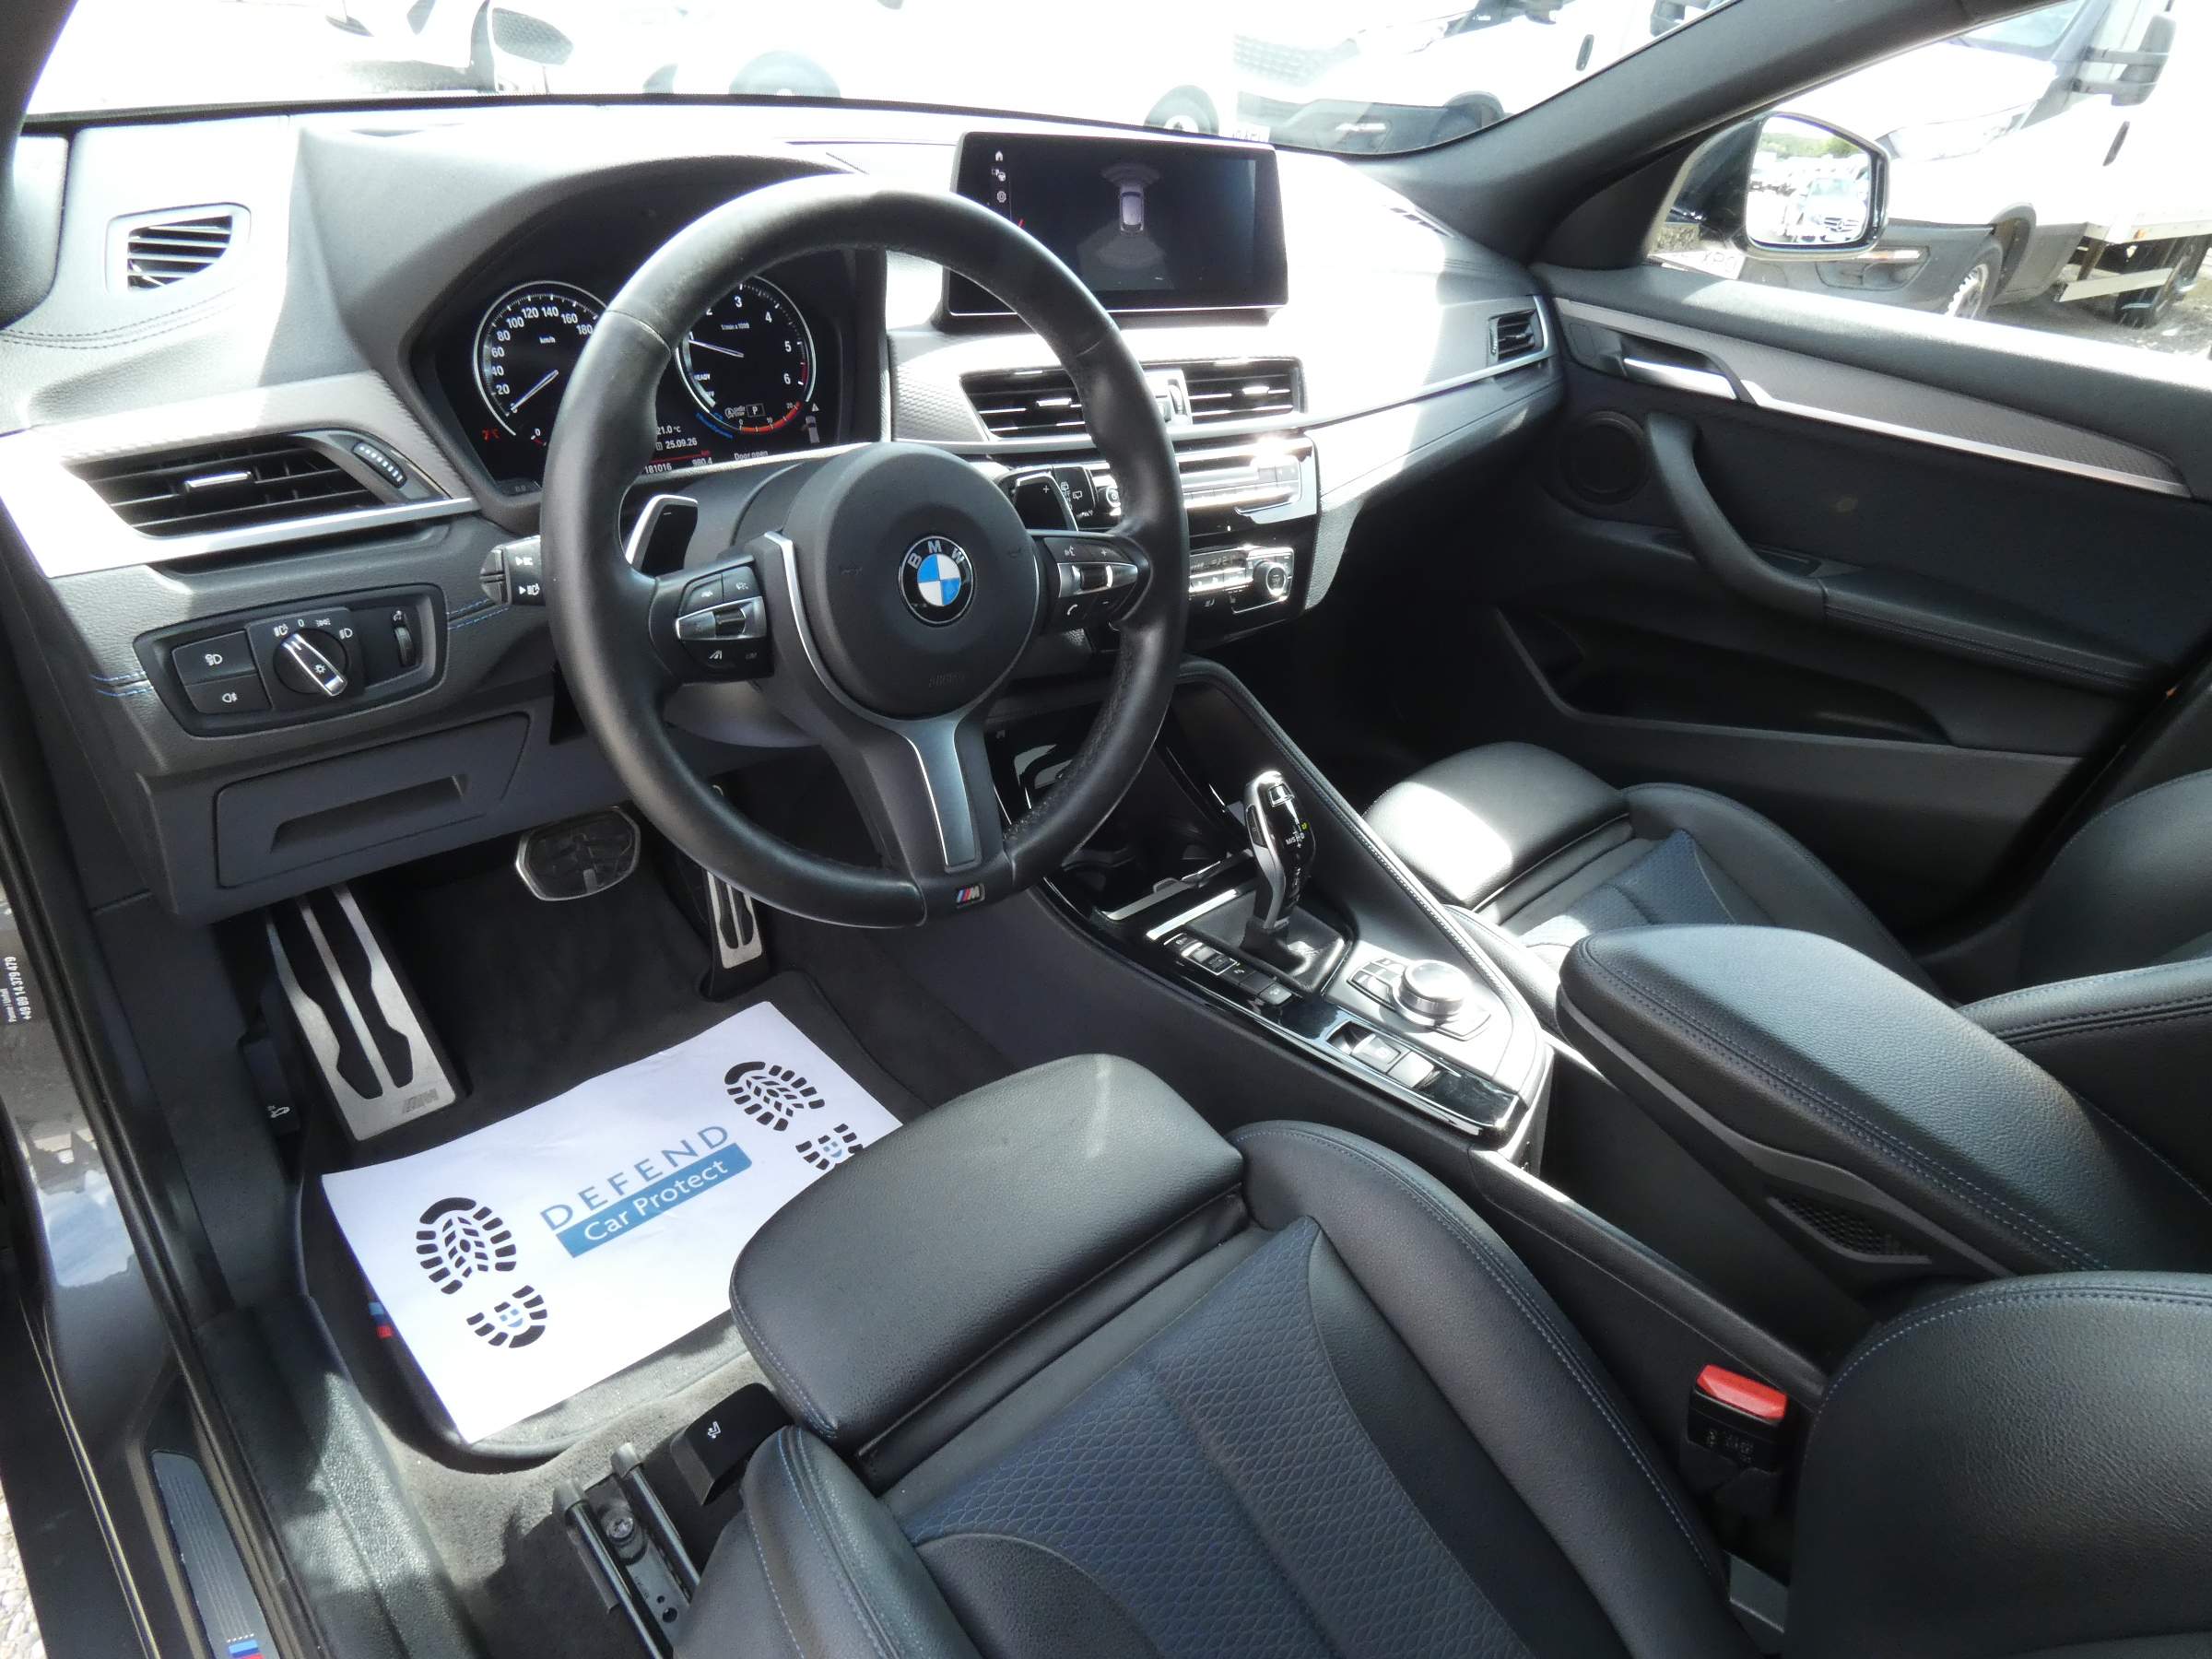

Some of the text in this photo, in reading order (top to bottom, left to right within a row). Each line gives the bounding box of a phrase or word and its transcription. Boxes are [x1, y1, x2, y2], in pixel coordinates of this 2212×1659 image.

[735, 296, 743, 308] 3
[522, 307, 539, 319] 120
[541, 306, 559, 318] 140
[765, 312, 772, 324] 4
[506, 316, 524, 329] 100
[560, 313, 578, 324] 160
[576, 324, 594, 335] 180
[497, 330, 511, 342] 80
[539, 335, 555, 344] km/h
[491, 347, 505, 358] 60
[784, 341, 792, 352] 5
[491, 365, 504, 377] 40
[783, 373, 791, 385] 6
[496, 383, 510, 395] 20
[752, 406, 758, 415] P
[535, 428, 541, 437] 0
[665, 437, 698, 450] 25.09.26
[734, 452, 750, 461] Door
[644, 463, 673, 474] 181016
[907, 539, 966, 570] BMW
[4, 956, 32, 1020] +49 89 14 379 479
[540, 1125, 728, 1231] DEFEND
[583, 1159, 728, 1241] Car Protect
